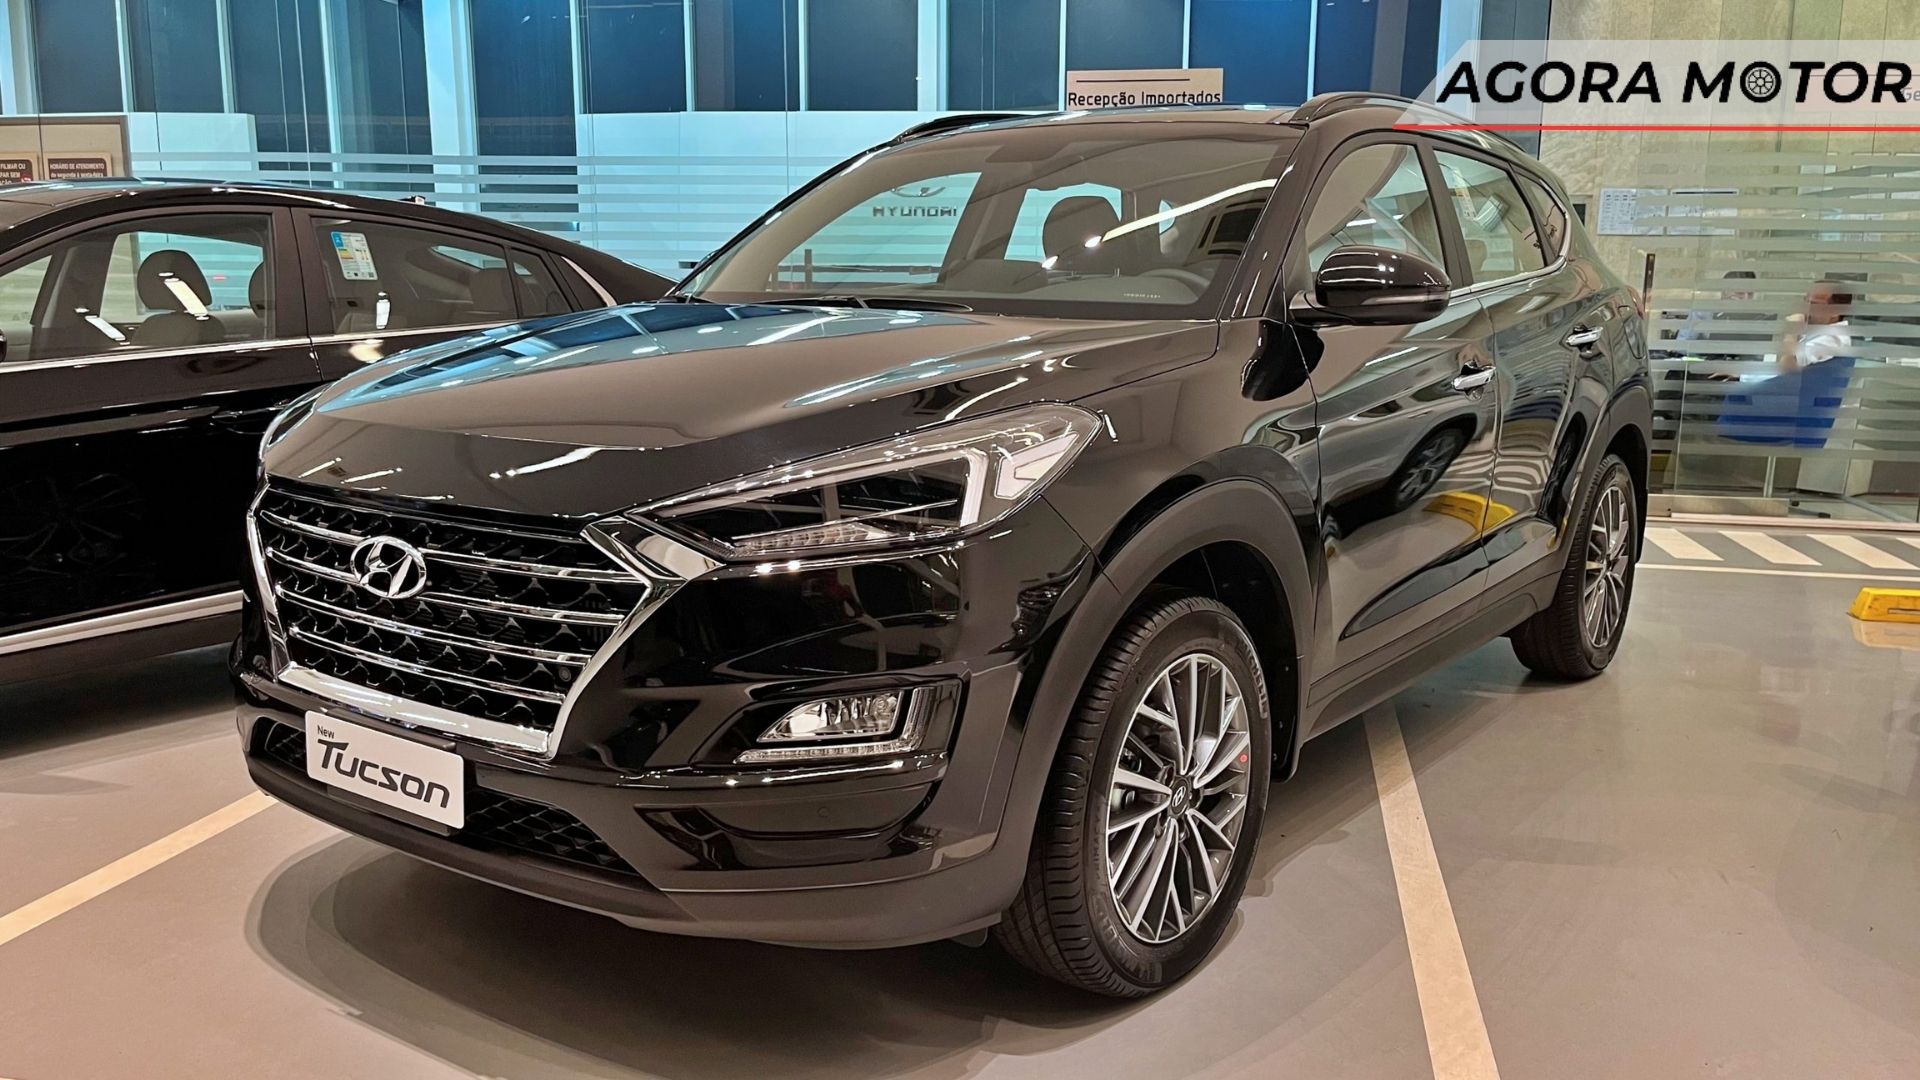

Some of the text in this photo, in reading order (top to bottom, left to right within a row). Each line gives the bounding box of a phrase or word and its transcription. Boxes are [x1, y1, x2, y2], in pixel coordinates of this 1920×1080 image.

[1068, 91, 1221, 107] Recepção Importados
[873, 206, 957, 217] HYUNDAI
[316, 725, 335, 740] New
[317, 738, 450, 809] Tucson
